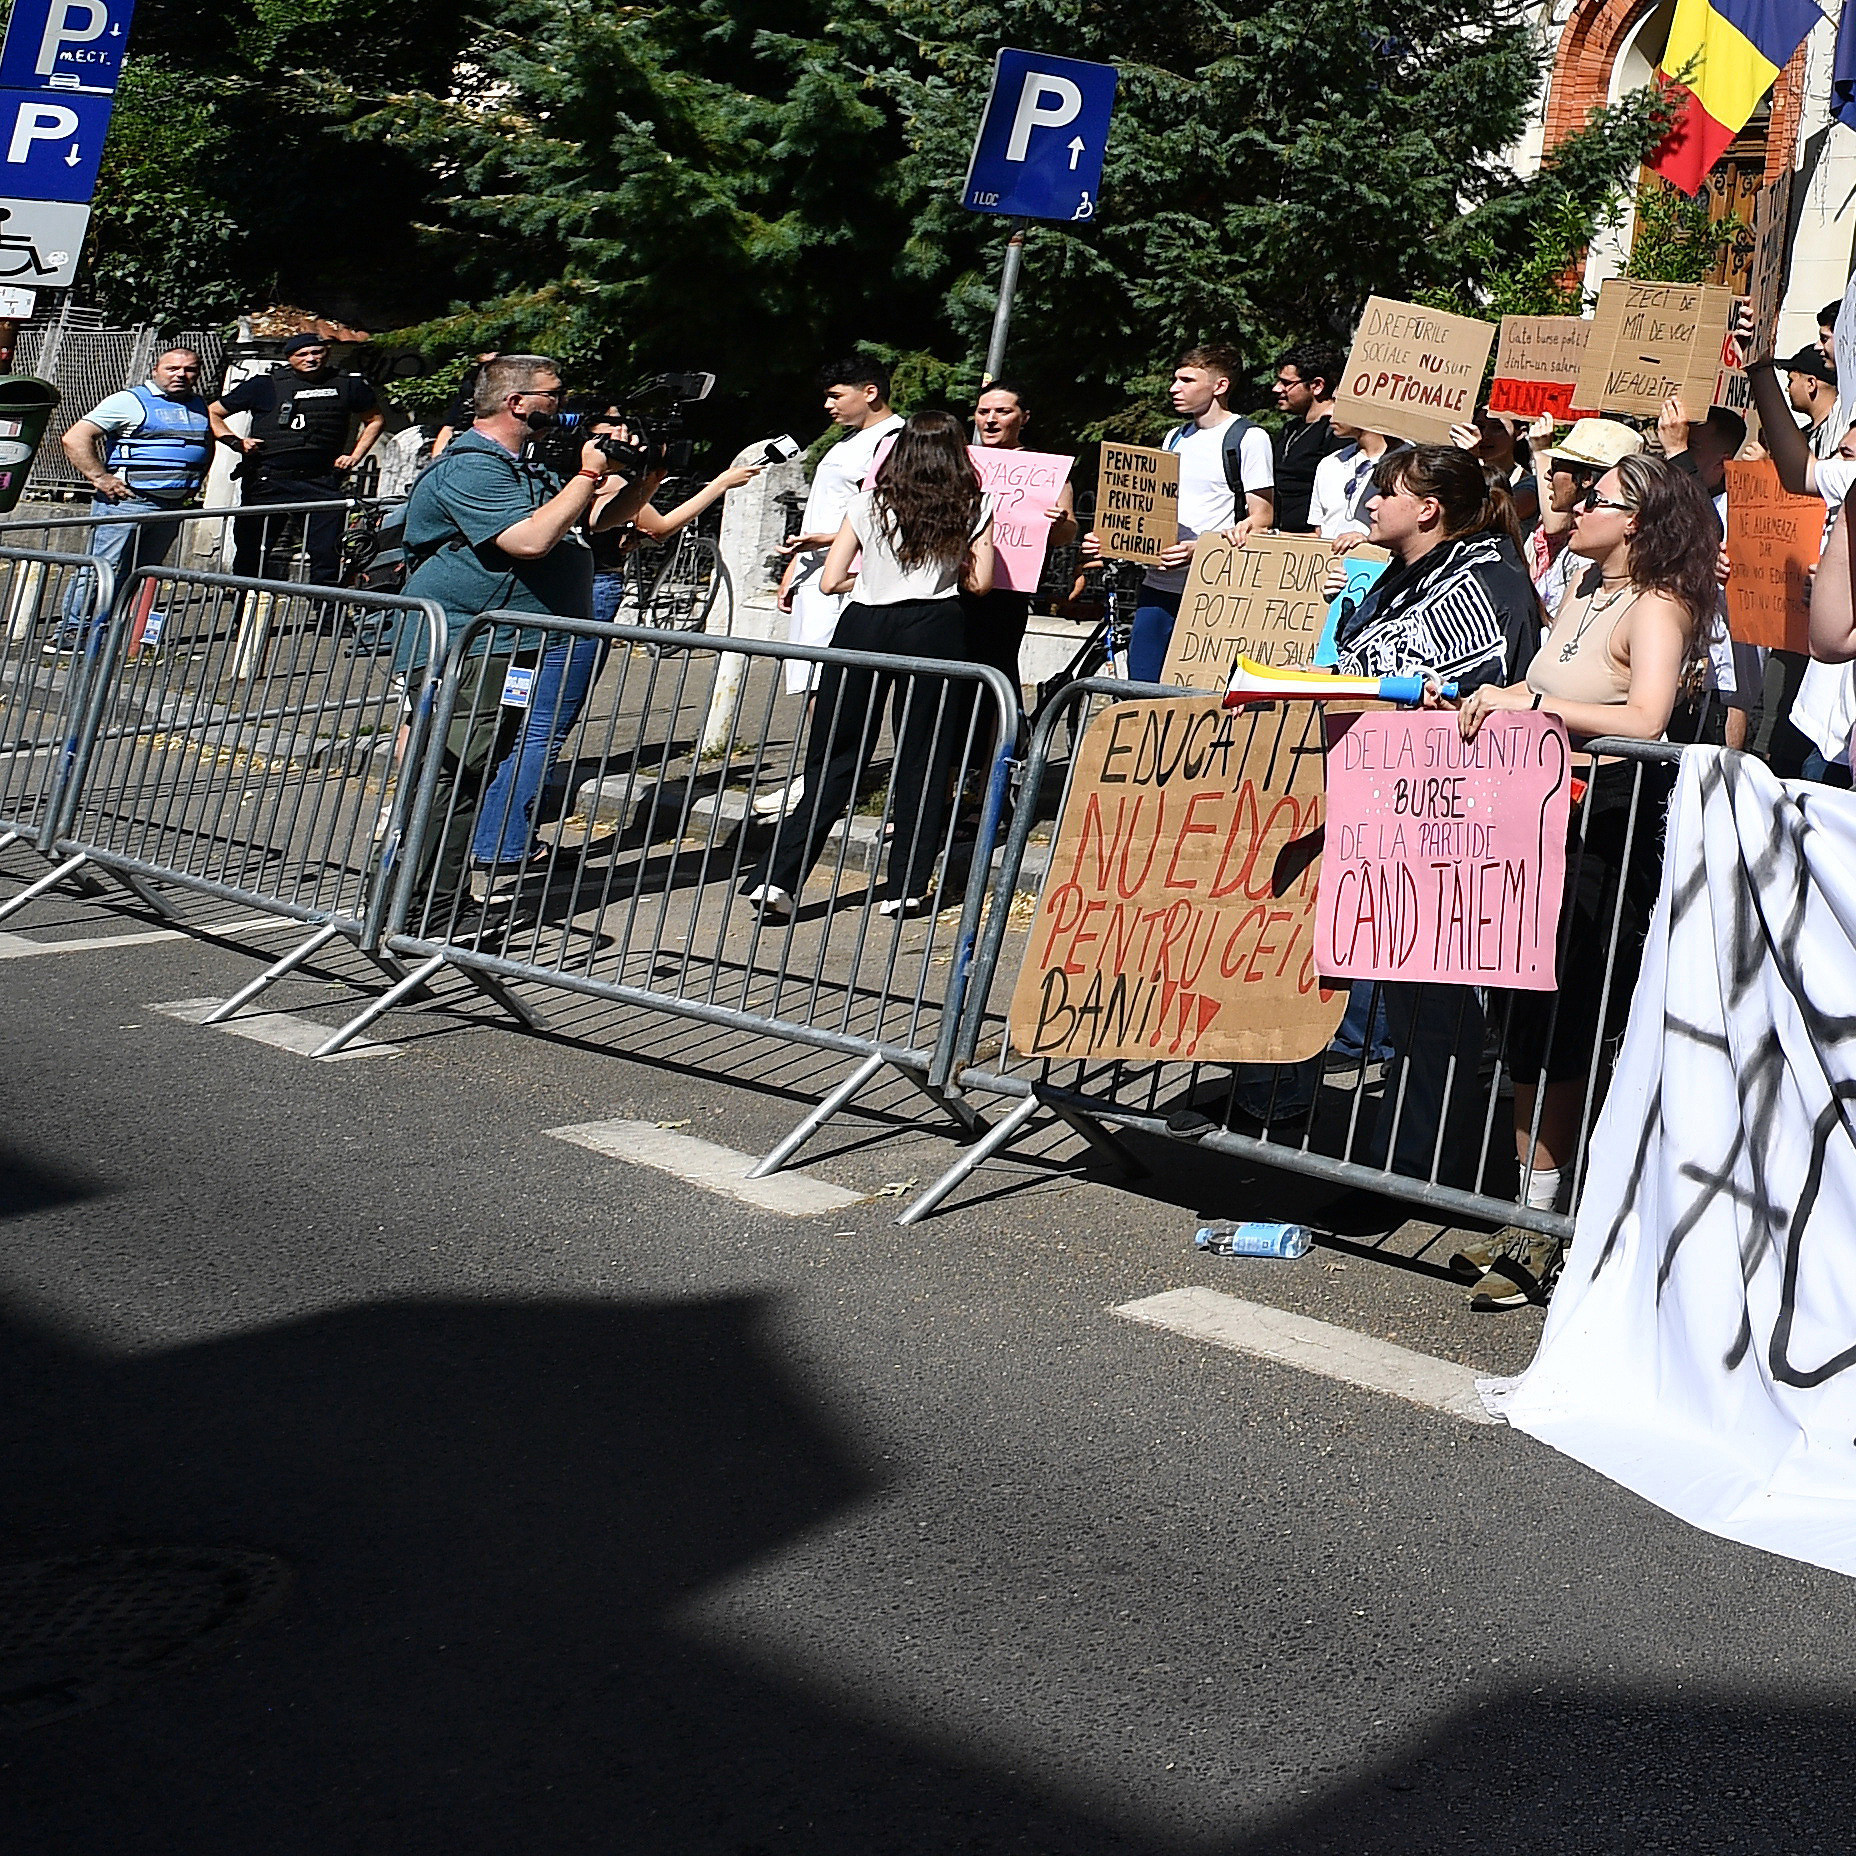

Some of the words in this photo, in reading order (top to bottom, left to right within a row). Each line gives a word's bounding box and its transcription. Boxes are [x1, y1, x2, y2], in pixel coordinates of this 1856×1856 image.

[1006, 71, 1081, 161] P
[7, 103, 78, 163] P
[979, 192, 999, 206] LOC
[1625, 286, 1670, 310] ZECI
[1679, 295, 1697, 312] DE
[1536, 325, 1559, 345] burse
[1650, 320, 1668, 340] DE
[1668, 323, 1696, 343] VOCI
[1419, 353, 1444, 373] NU
[1605, 370, 1683, 399] NEAUZITE
[1107, 450, 1157, 474] PENTRU
[1104, 471, 1130, 488] TINE
[1132, 475, 1140, 490] E
[1140, 477, 1156, 494] UN
[1108, 489, 1154, 513] PENTRU
[1102, 511, 1132, 532] MINE
[1137, 516, 1146, 534] E
[1110, 532, 1162, 557] CHIRIA!
[1279, 551, 1342, 593] BURS
[1261, 598, 1319, 632] FACE
[1345, 729, 1377, 770] DE
[1383, 728, 1415, 769] LA
[1424, 727, 1532, 775] STUDENȚI
[1394, 777, 1467, 819] BURSE
[1071, 790, 1165, 899] NU
[1164, 791, 1226, 890] E
[1208, 779, 1325, 899] DOA
[1340, 823, 1368, 861] DE
[1378, 823, 1408, 858] LA
[1418, 822, 1497, 860] PARTIDE
[1332, 860, 1419, 970] CÂND
[1431, 858, 1526, 974] TĂIEM
[1040, 882, 1221, 990] PENTRU
[1220, 903, 1313, 983] CEI
